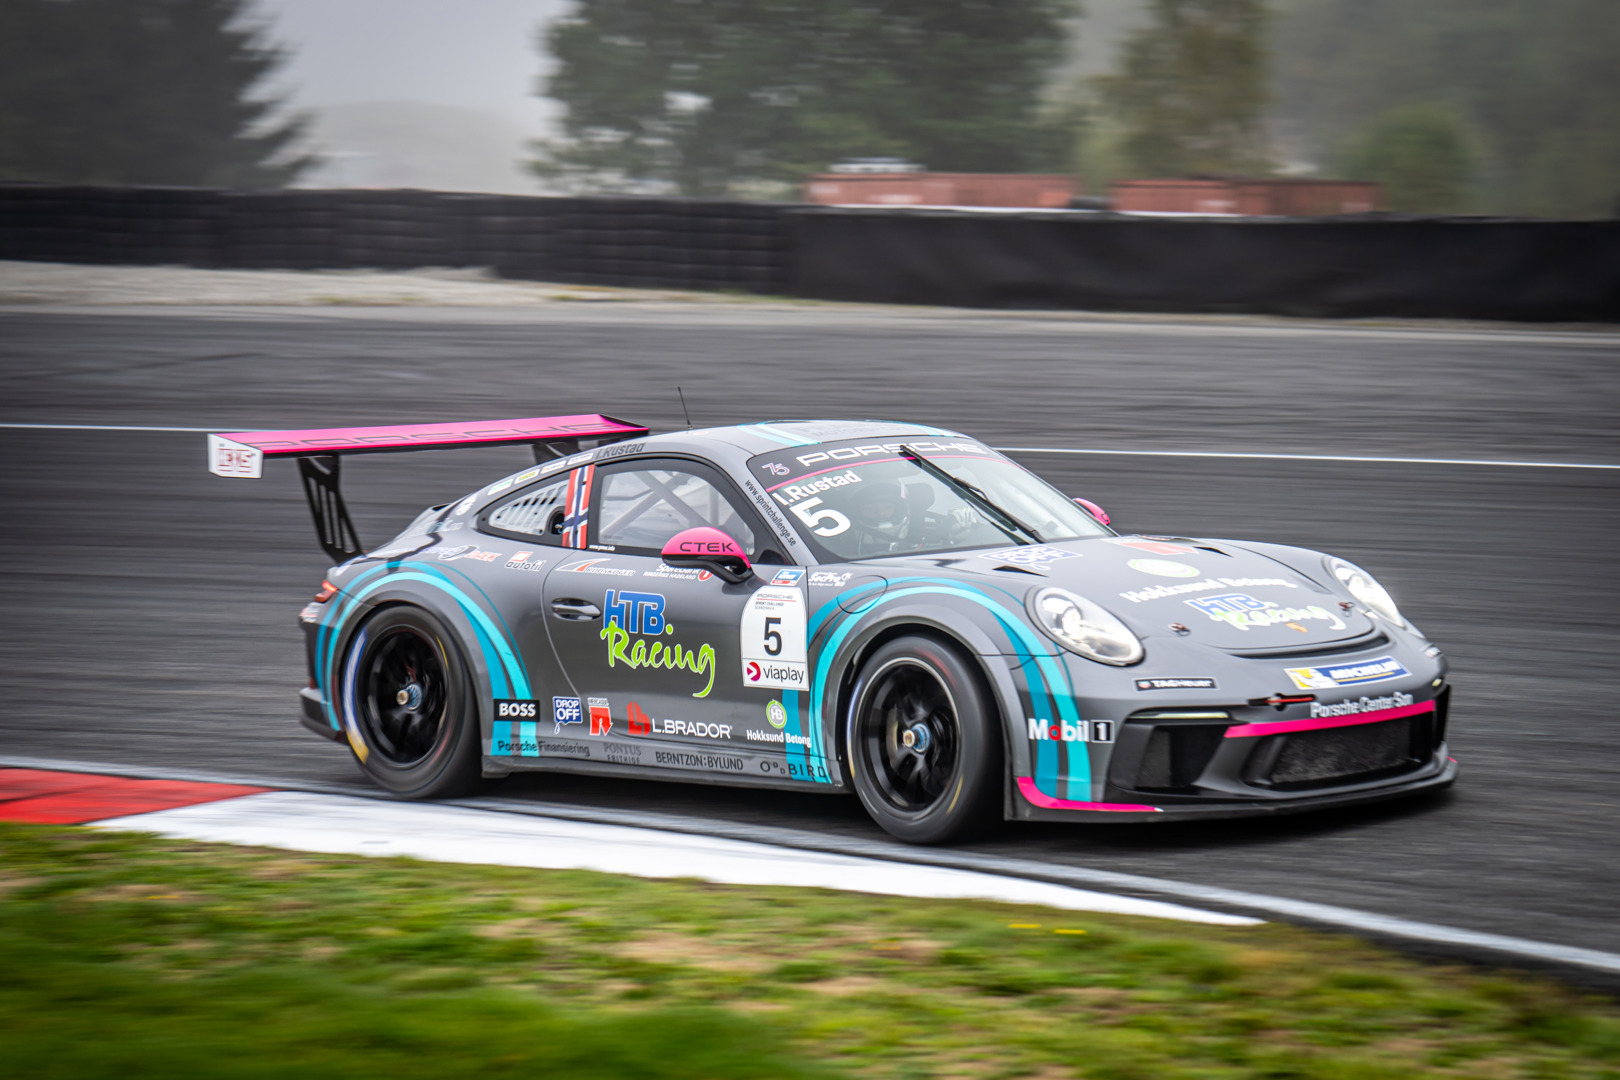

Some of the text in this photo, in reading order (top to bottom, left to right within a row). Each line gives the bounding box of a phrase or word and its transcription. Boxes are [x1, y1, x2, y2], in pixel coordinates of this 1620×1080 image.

[796, 442, 987, 467] PORSCHE
[772, 470, 862, 506] I.Rustad
[745, 479, 797, 547] www.sprintchallenge.se
[789, 497, 851, 537] 5
[680, 542, 734, 552] CTEK
[603, 589, 666, 635] HTB
[764, 617, 782, 656] 5
[600, 620, 716, 698] Racing
[763, 665, 804, 684] viaplay
[1329, 661, 1401, 680] MICHELIN
[499, 703, 536, 717] BOSS
[556, 699, 579, 709] DROP
[556, 708, 580, 720] OFF
[1310, 699, 1360, 718] Porsche
[1359, 695, 1394, 713] Center
[652, 718, 732, 740] L.BRADOR
[746, 729, 812, 749] Hokksund Betong
[1028, 718, 1107, 743] Mobil 1
[498, 740, 591, 758] Porsche Finansiering
